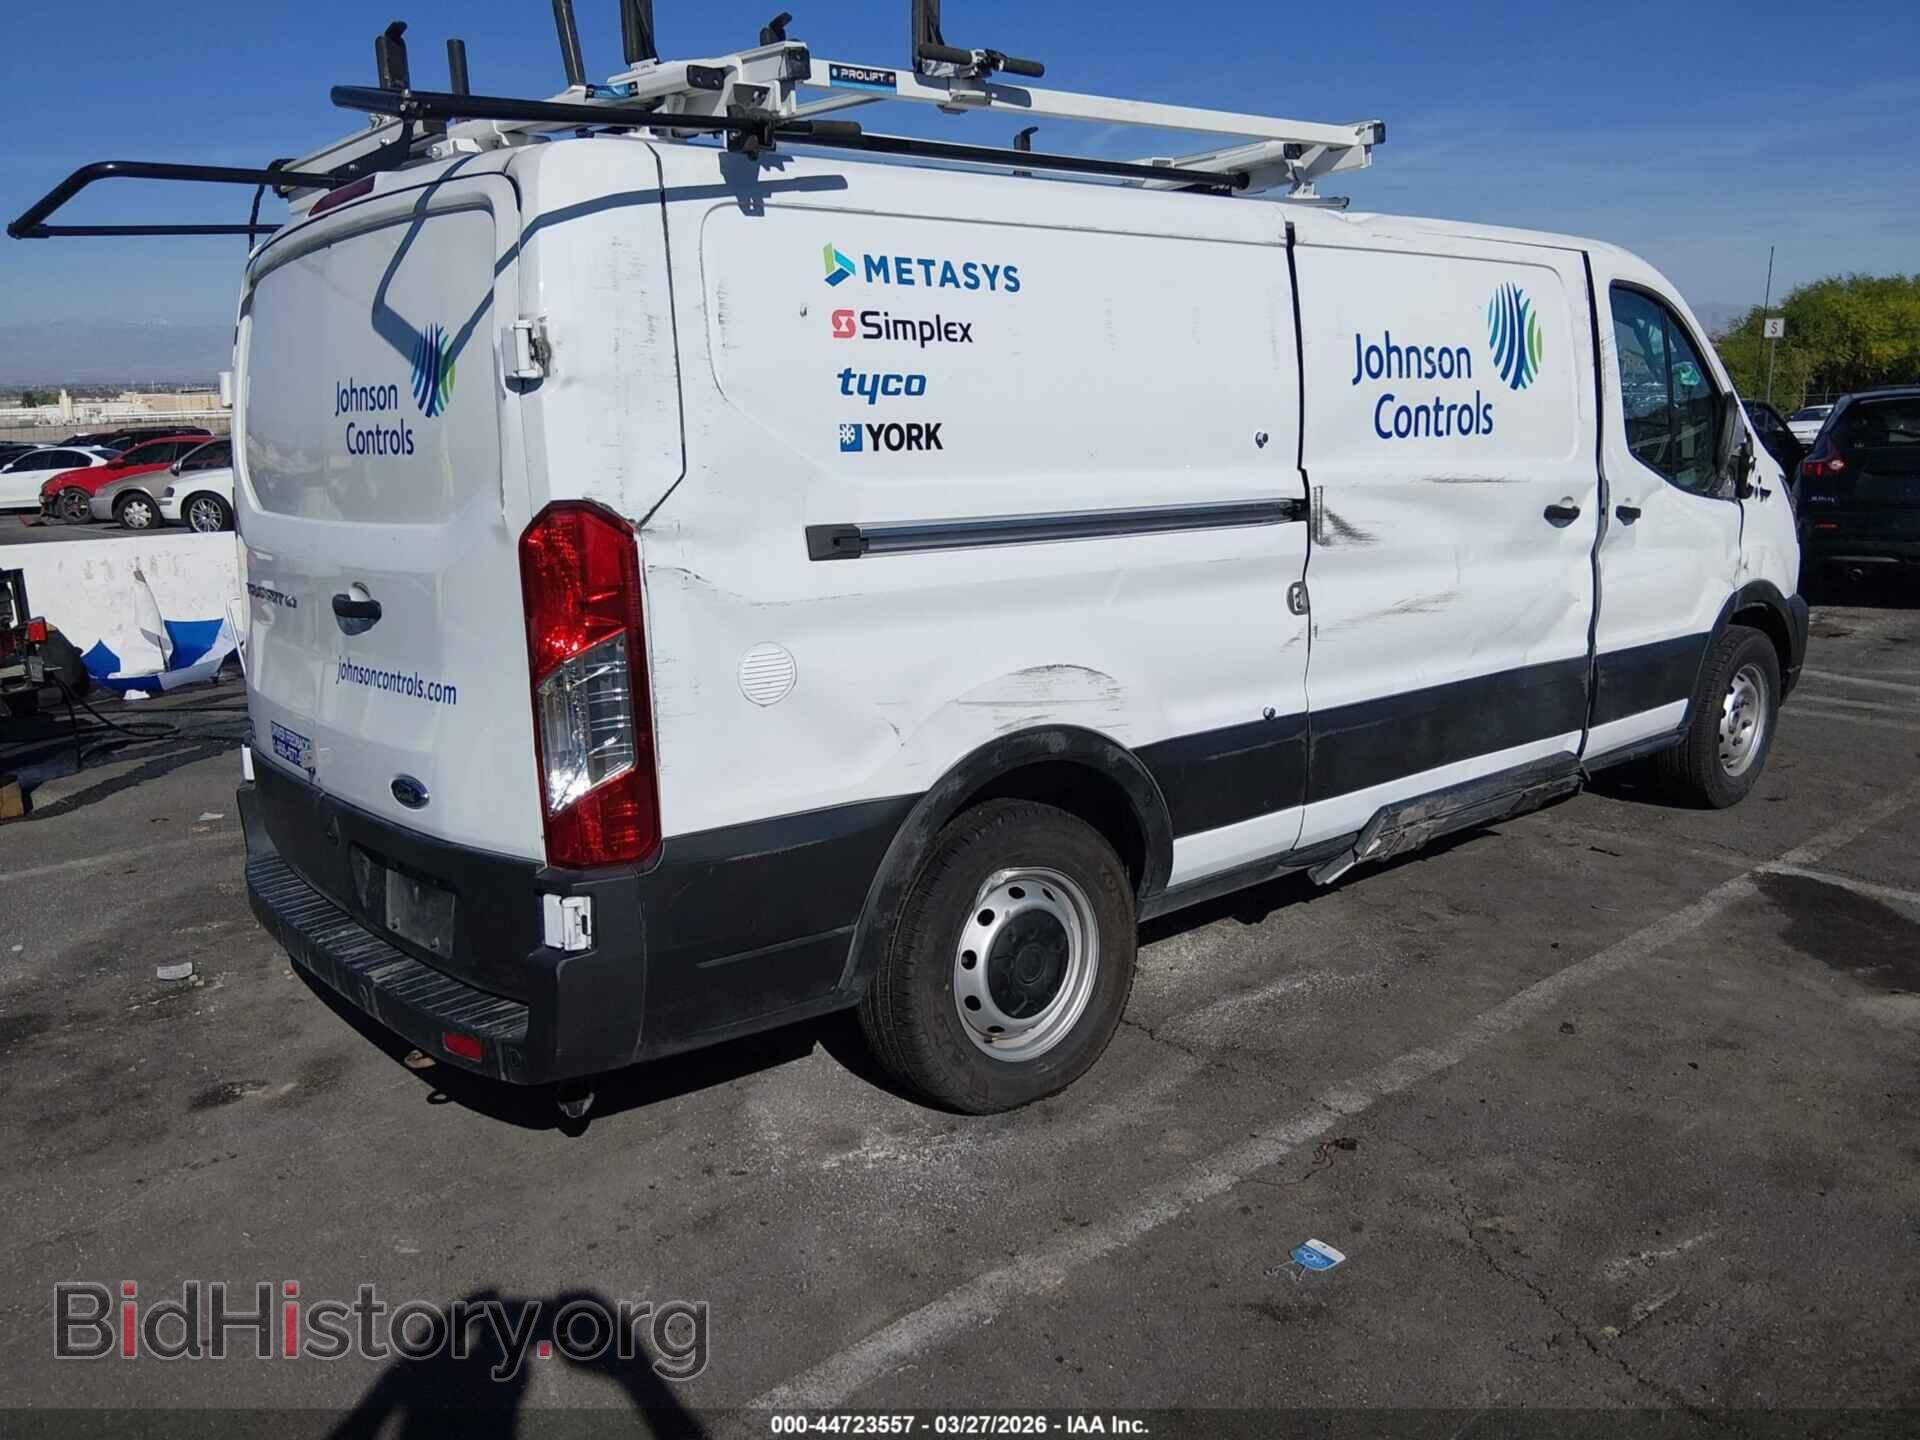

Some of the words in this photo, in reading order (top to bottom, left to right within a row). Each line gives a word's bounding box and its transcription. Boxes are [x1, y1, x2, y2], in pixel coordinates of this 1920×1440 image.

[841, 68, 885, 81] PROLIFT
[863, 254, 1021, 293] METASYS
[860, 310, 974, 349] Simplex
[1351, 330, 1472, 386] Johnson
[335, 377, 398, 417] Johnson
[836, 367, 927, 405] tyco
[1374, 389, 1494, 440] Controls
[346, 418, 415, 456] Controls
[865, 422, 944, 452] YORK
[335, 655, 457, 705] johnsoncontrols.com
